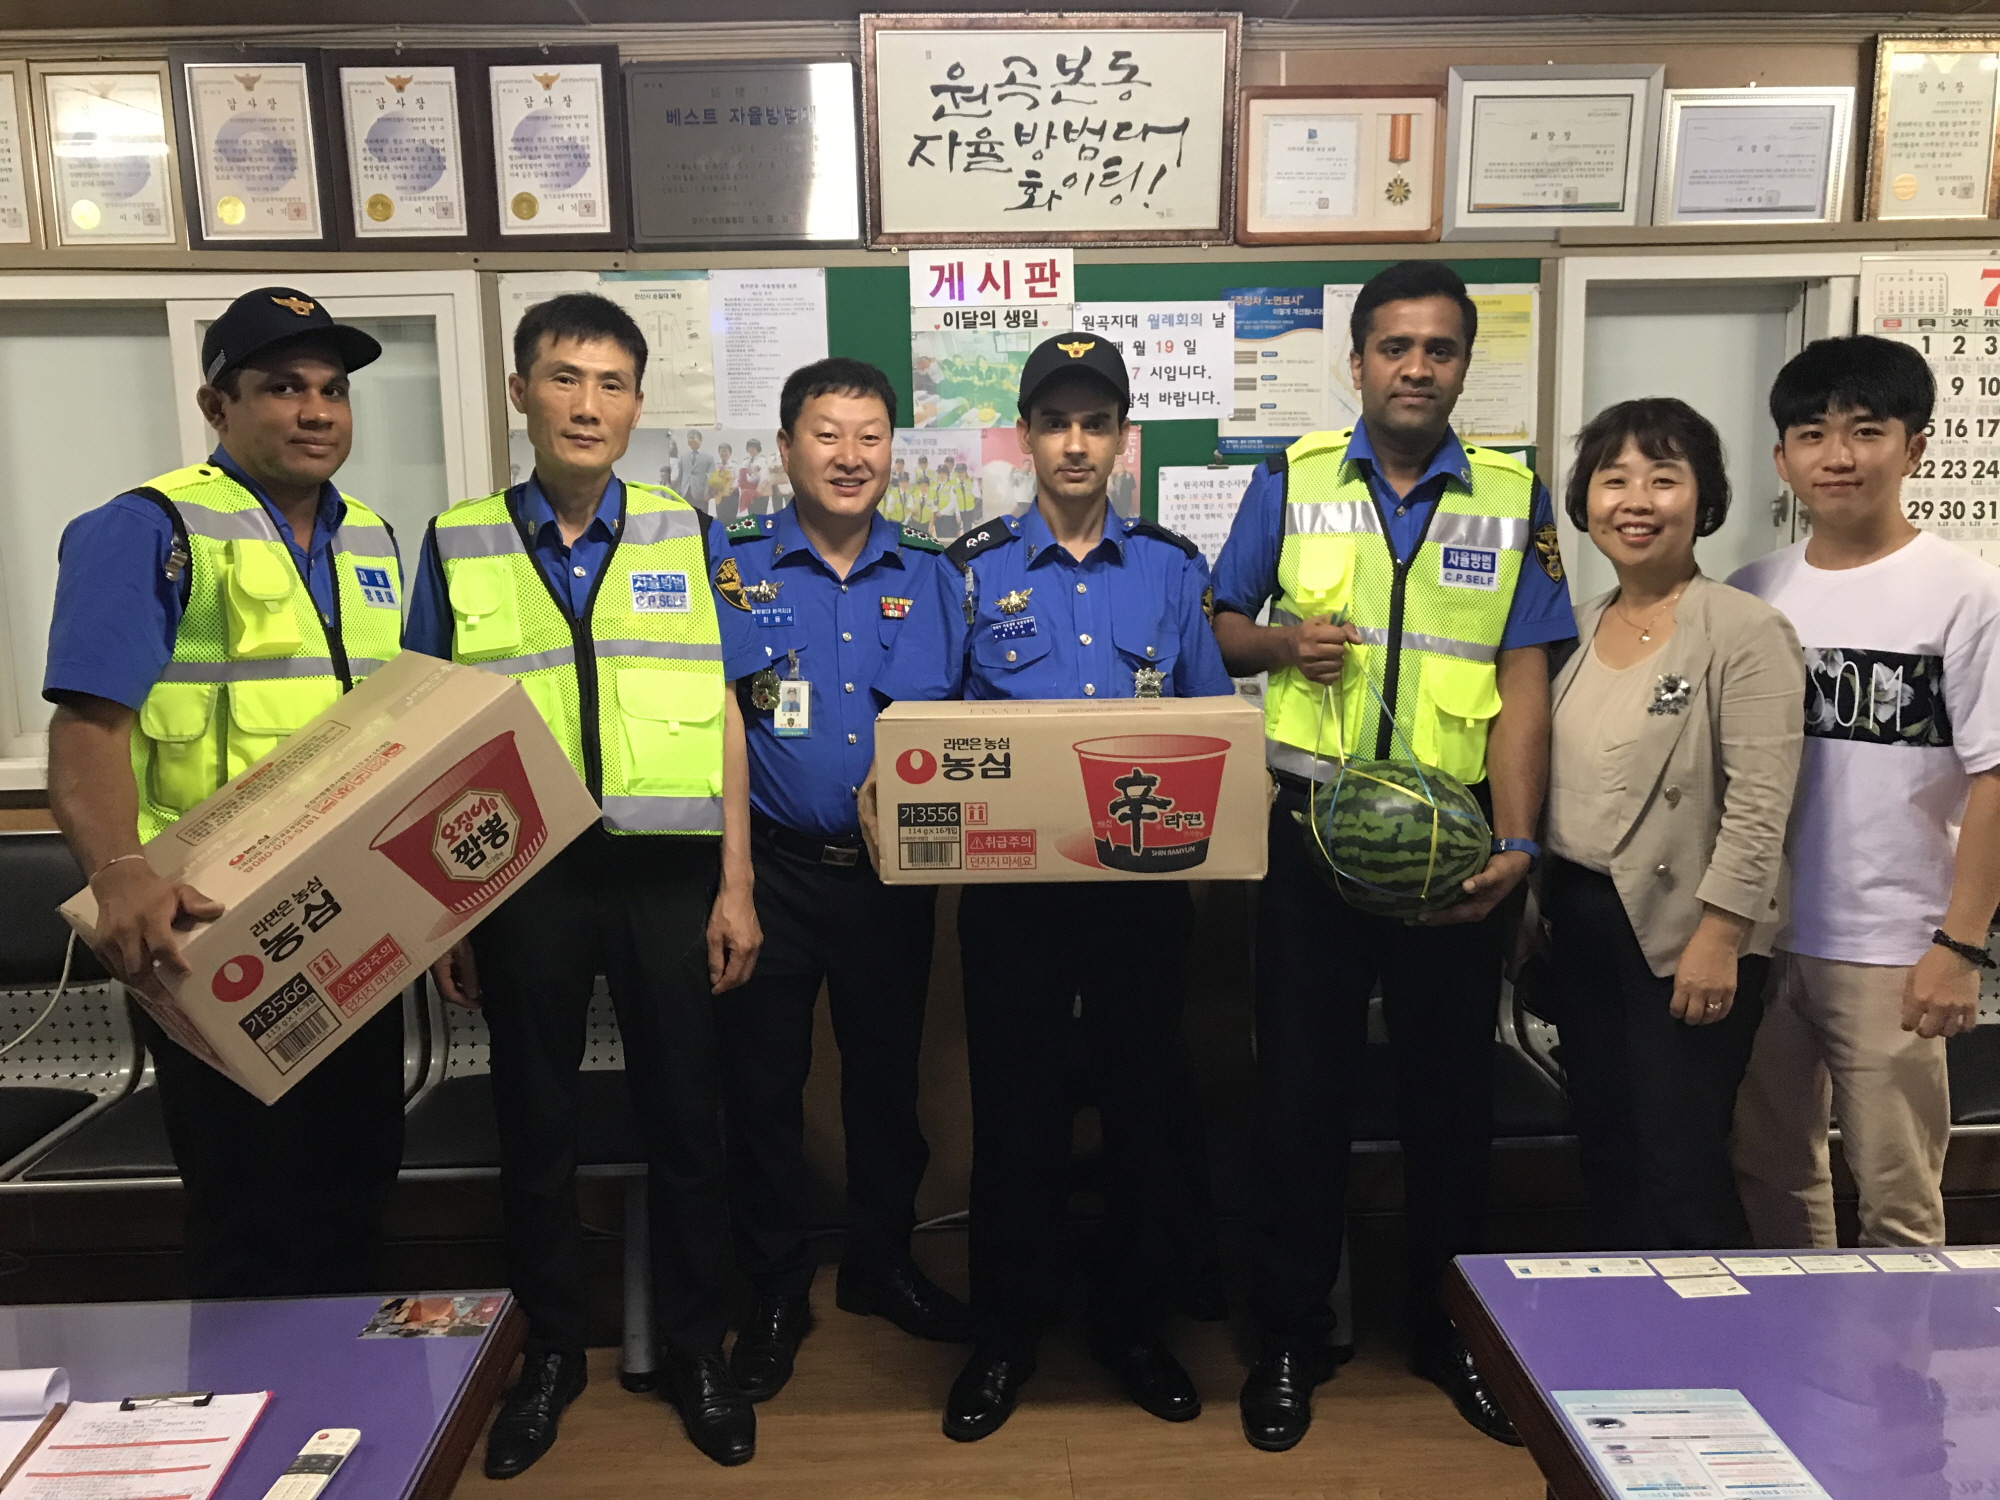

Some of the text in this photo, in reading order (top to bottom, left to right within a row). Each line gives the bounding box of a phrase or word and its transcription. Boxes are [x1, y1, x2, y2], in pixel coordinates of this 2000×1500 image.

[930, 45, 1152, 122] 원곡본동
[665, 107, 718, 127] 베스트
[907, 116, 1190, 173] 자율방범대
[1003, 155, 1168, 213] 화이팅!
[929, 258, 1061, 301] 게시판
[943, 309, 1039, 329] 이달의 생일
[1081, 314, 1138, 331] 원곡지대
[1147, 313, 1203, 329] 월례회의
[1212, 312, 1226, 328] 날
[1951, 319, 1969, 327] 火
[1133, 341, 1146, 356] 월
[1156, 340, 1174, 353] 19
[1183, 339, 1197, 355] 일
[1922, 335, 1998, 355] 1 2 3
[1132, 365, 1212, 381] 7 시입니다.
[1951, 376, 2000, 396] 9 10
[1159, 391, 1221, 408] 바랍니다.
[1921, 418, 2000, 437] 5 16 17
[1941, 459, 1967, 479] 23
[1972, 459, 1999, 479] 24
[1907, 501, 1997, 520] 29 30 31
[1448, 550, 1492, 570] 자율방범
[943, 737, 1010, 751] 라면은 농심
[941, 752, 1011, 781] 농심
[901, 806, 958, 824] 가3556
[1109, 767, 1174, 856] 辛
[1164, 812, 1205, 831] 라면
[440, 796, 491, 849] 오징어
[450, 812, 510, 871] 짬뽕
[985, 836, 1032, 849] 취급주의
[1151, 846, 1196, 857] SHIN RAMYUN
[970, 856, 1032, 867] 던지지 마세요
[250, 875, 324, 938] 라면은 농심
[260, 889, 343, 963] 농심
[347, 942, 395, 985] 취급주의
[345, 960, 407, 1013] 던지지 마세요
[244, 978, 309, 1033] 가3566
[265, 1024, 281, 1040] 115
